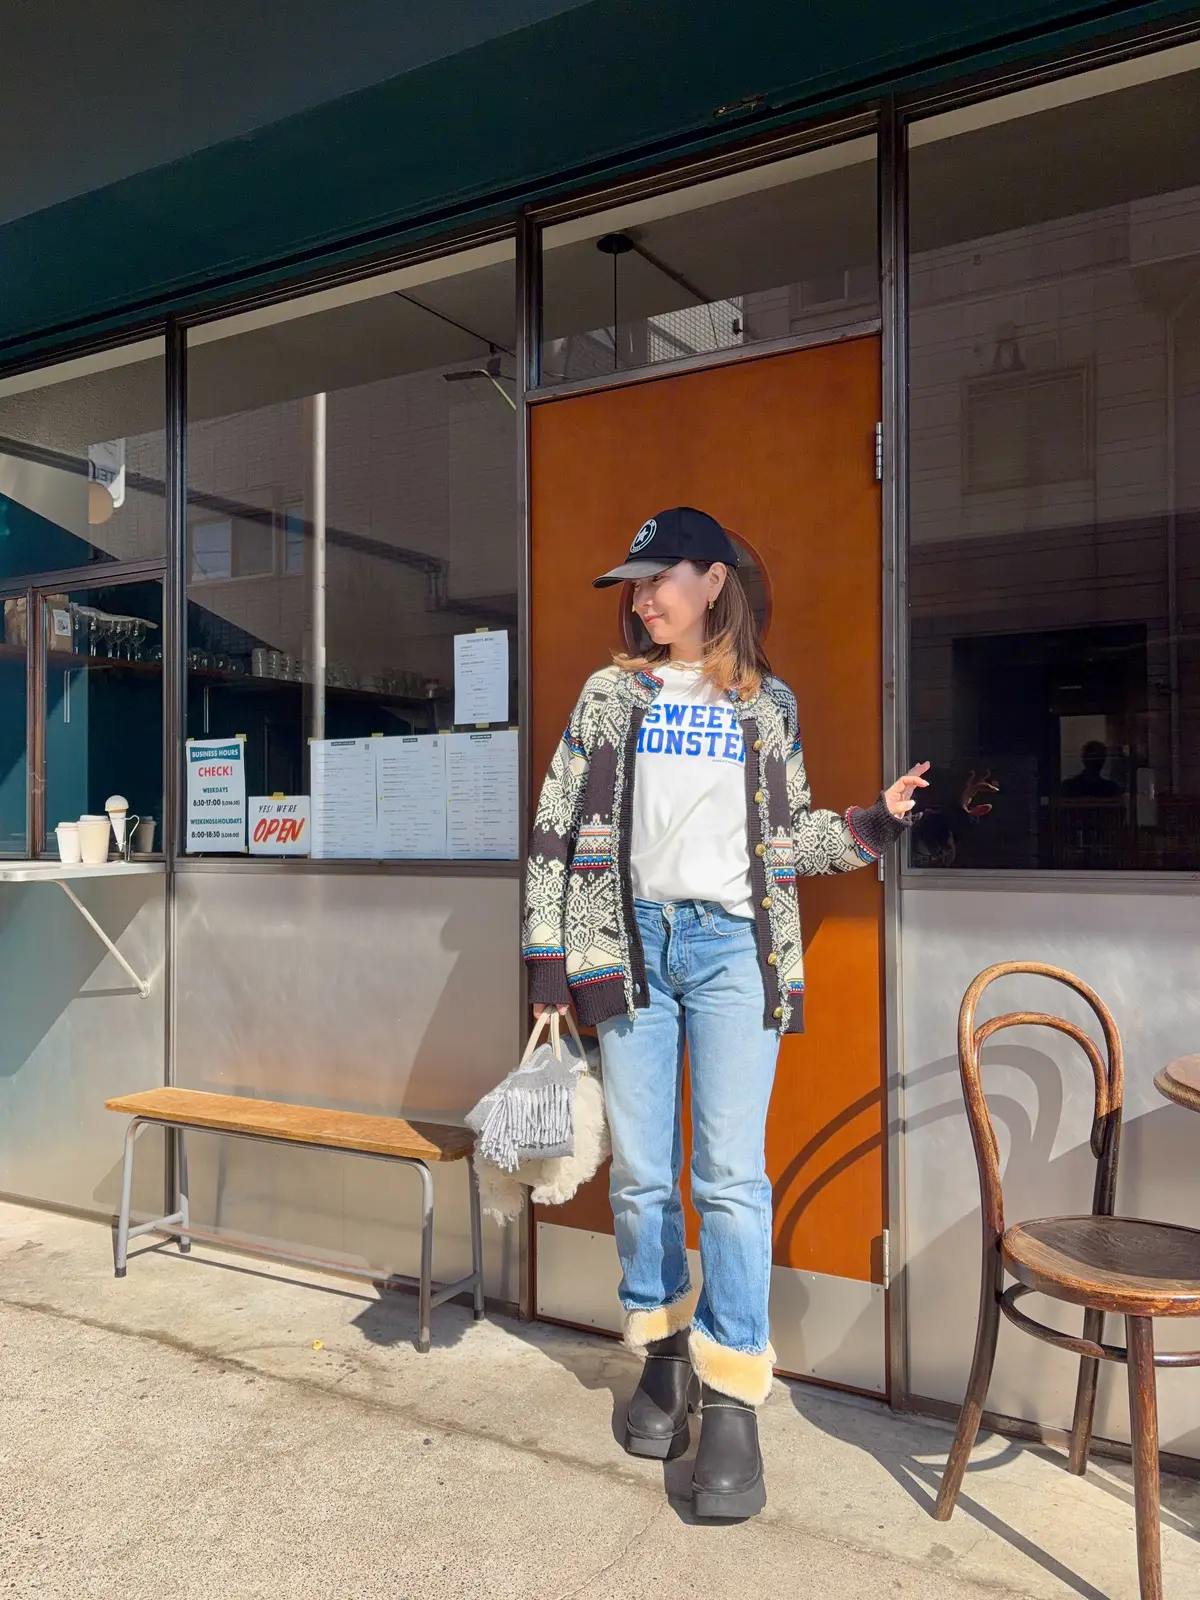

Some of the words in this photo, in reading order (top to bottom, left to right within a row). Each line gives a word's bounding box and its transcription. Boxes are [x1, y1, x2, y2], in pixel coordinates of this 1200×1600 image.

[645, 703, 738, 730] SWEET
[192, 749, 218, 758] BUSINESS
[219, 749, 238, 757] HOURS
[198, 765, 233, 777] CHECK!
[193, 799, 221, 807] 8:30-17:00
[191, 830, 220, 838] 8:00-18:30
[254, 818, 305, 843] OPEN
